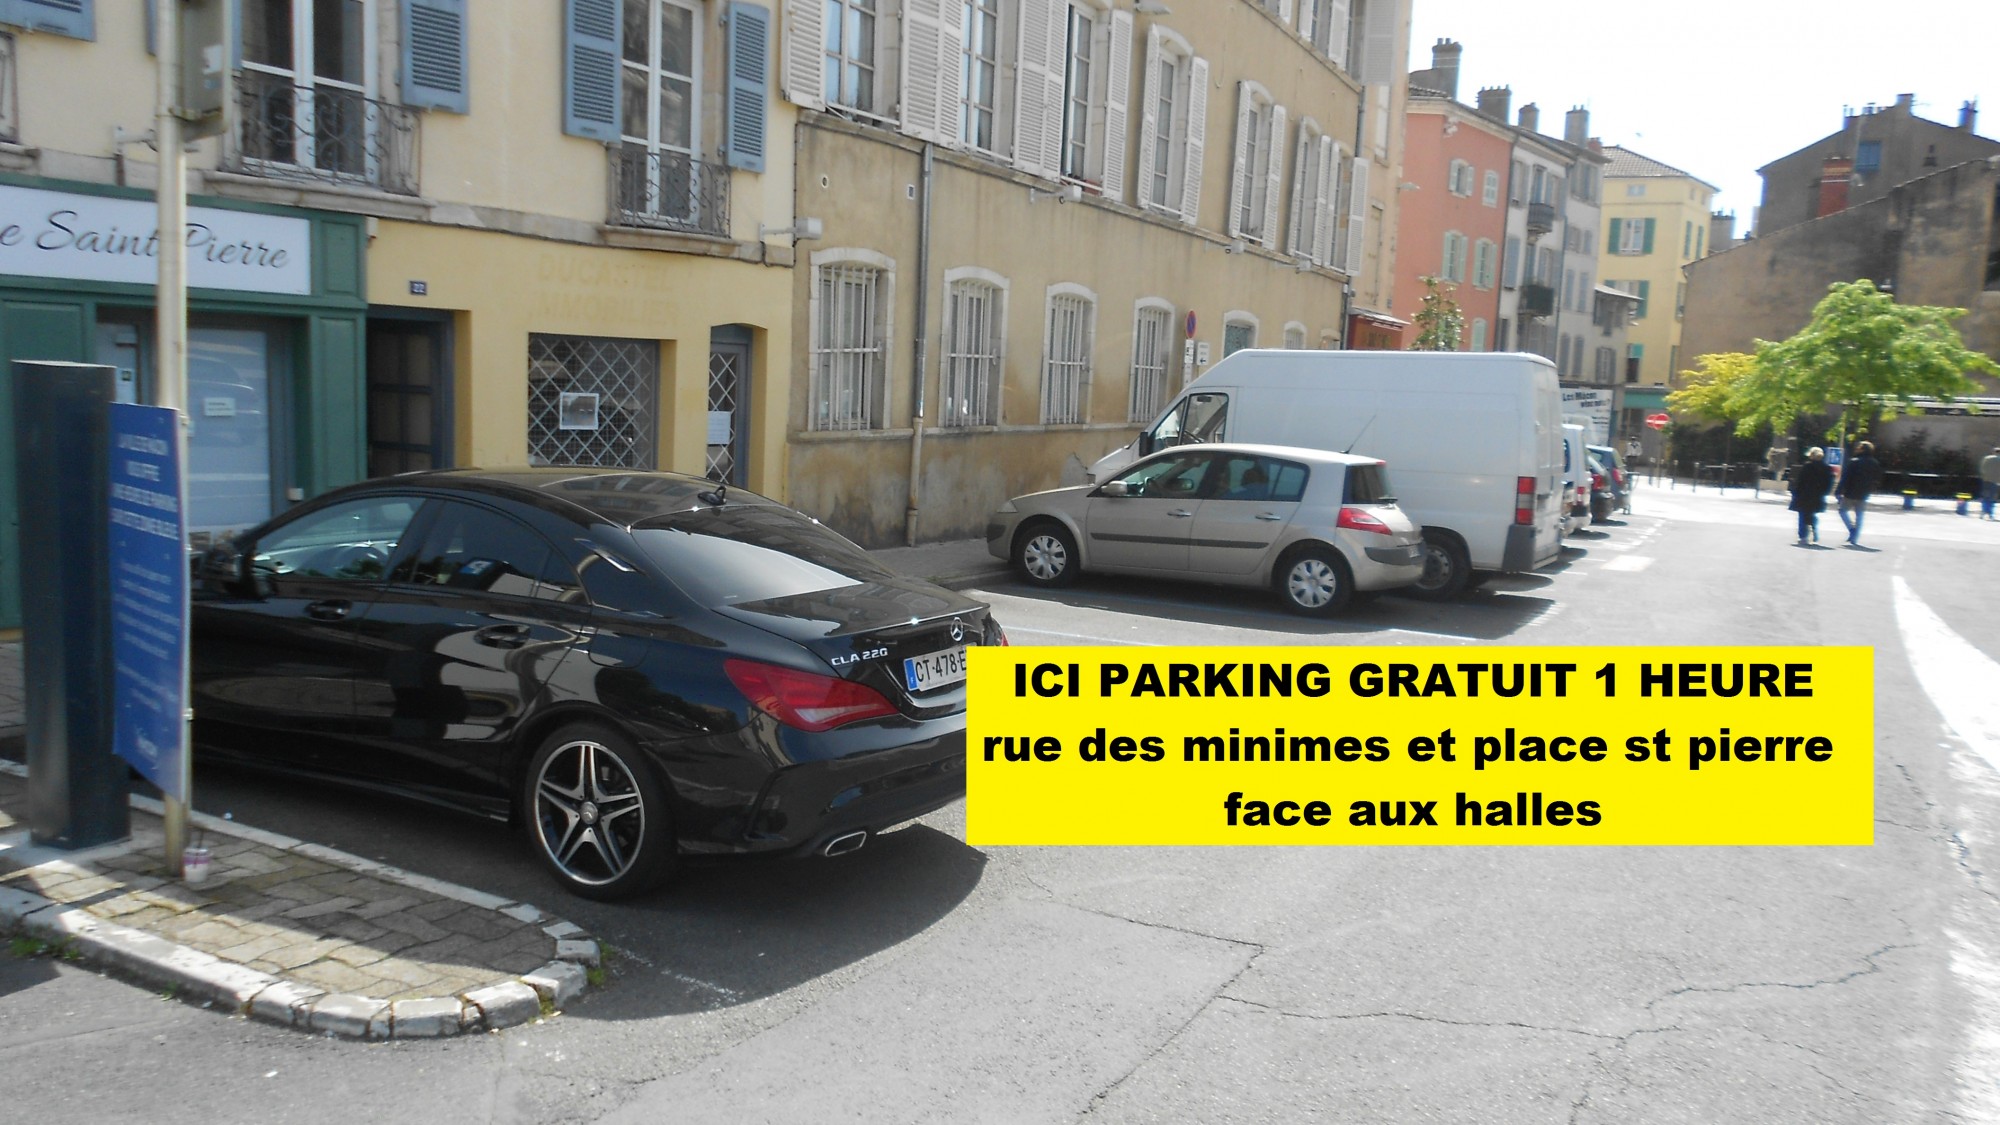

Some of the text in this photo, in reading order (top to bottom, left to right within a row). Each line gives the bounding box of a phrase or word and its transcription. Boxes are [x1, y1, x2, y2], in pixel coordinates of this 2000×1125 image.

[36, 210, 158, 257] Saint
[186, 223, 289, 269] Pierre
[831, 647, 888, 666] CLA 220
